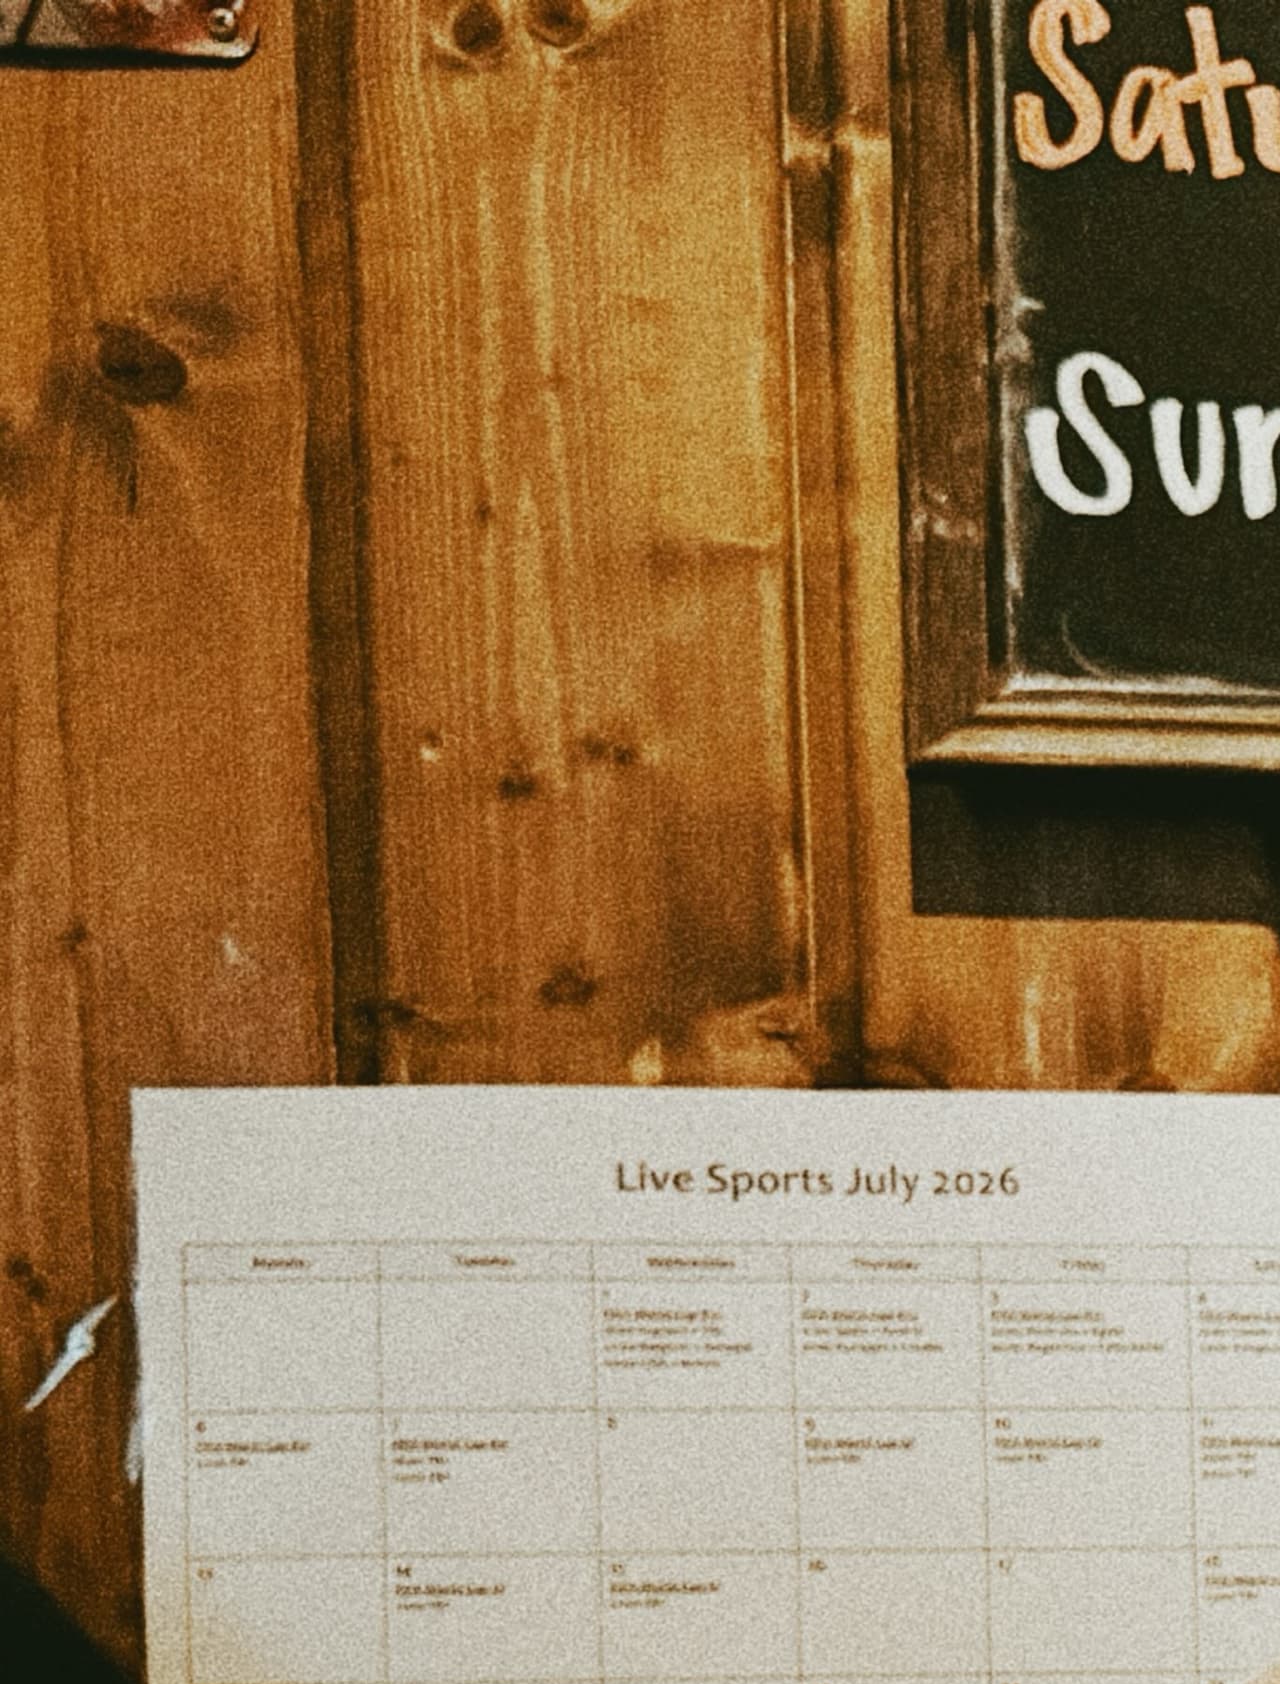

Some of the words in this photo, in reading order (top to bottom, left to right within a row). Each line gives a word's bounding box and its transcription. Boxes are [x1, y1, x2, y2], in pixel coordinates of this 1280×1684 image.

[616, 1162, 694, 1194] Live
[706, 1163, 832, 1200] Sports
[846, 1165, 919, 1204] July
[933, 1167, 1020, 1195] 2026
